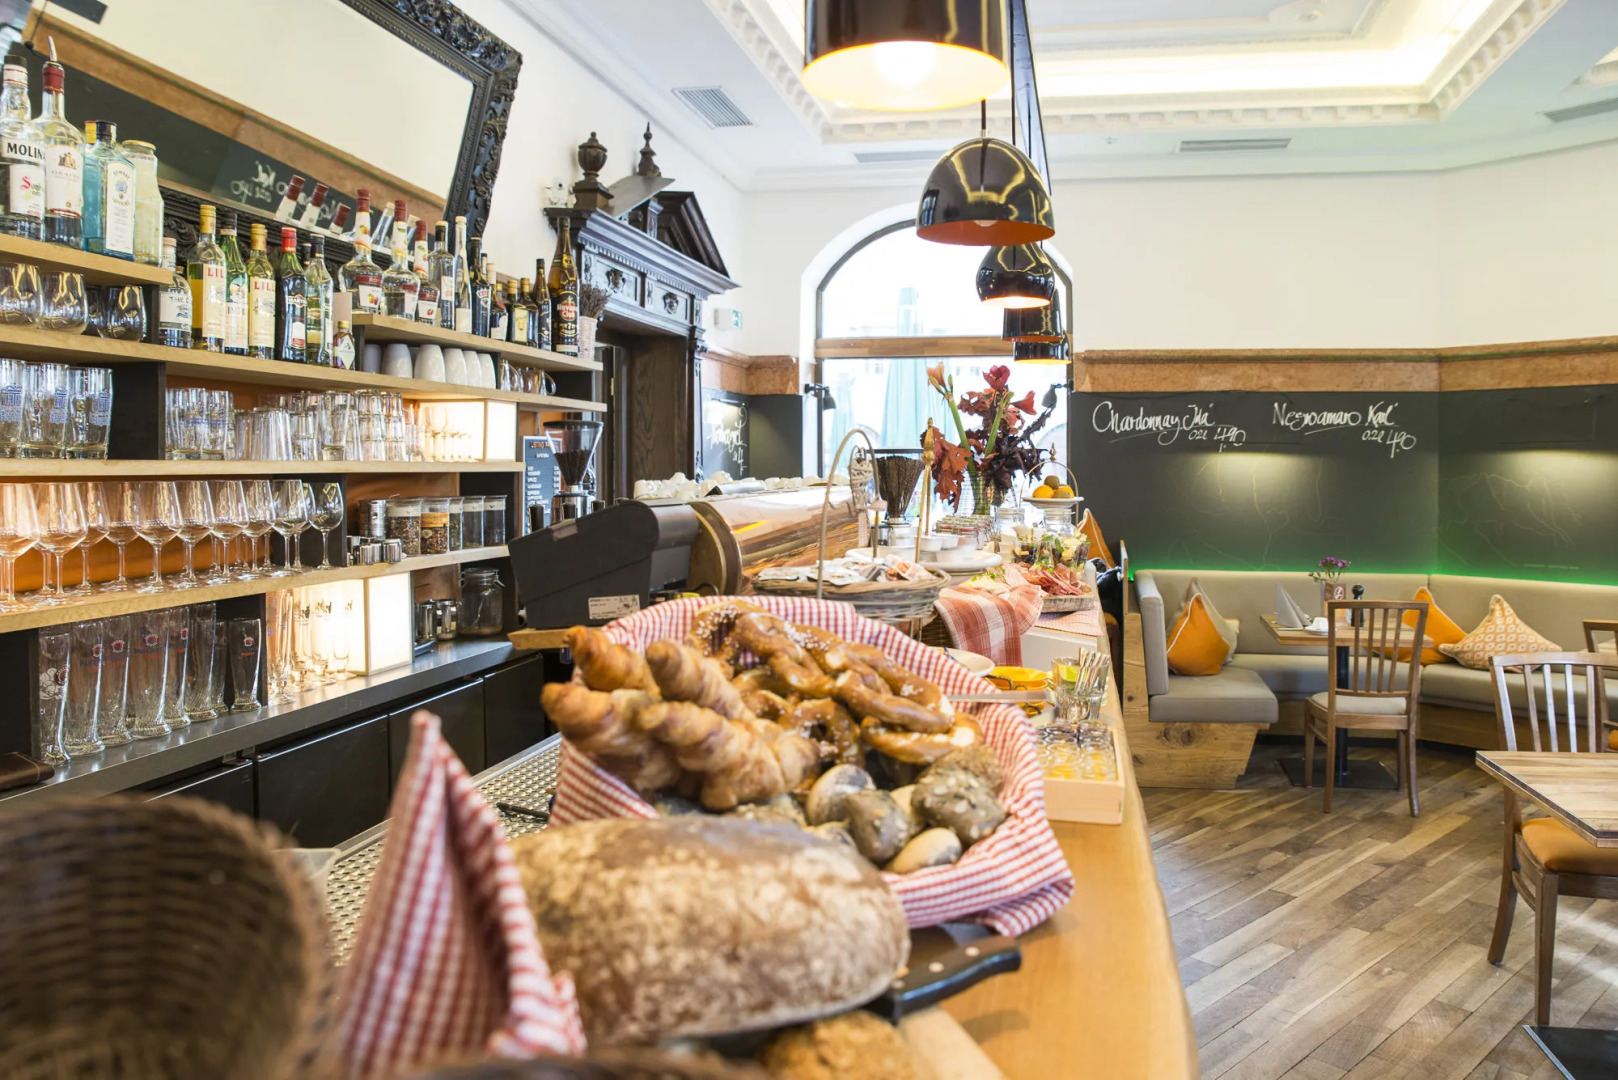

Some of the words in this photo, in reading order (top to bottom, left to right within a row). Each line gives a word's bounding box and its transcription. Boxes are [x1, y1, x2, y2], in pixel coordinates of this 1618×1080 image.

[7, 142, 45, 160] MOLIN
[1092, 401, 1181, 446] Chardonnay
[1272, 402, 1362, 431] Negroamaro
